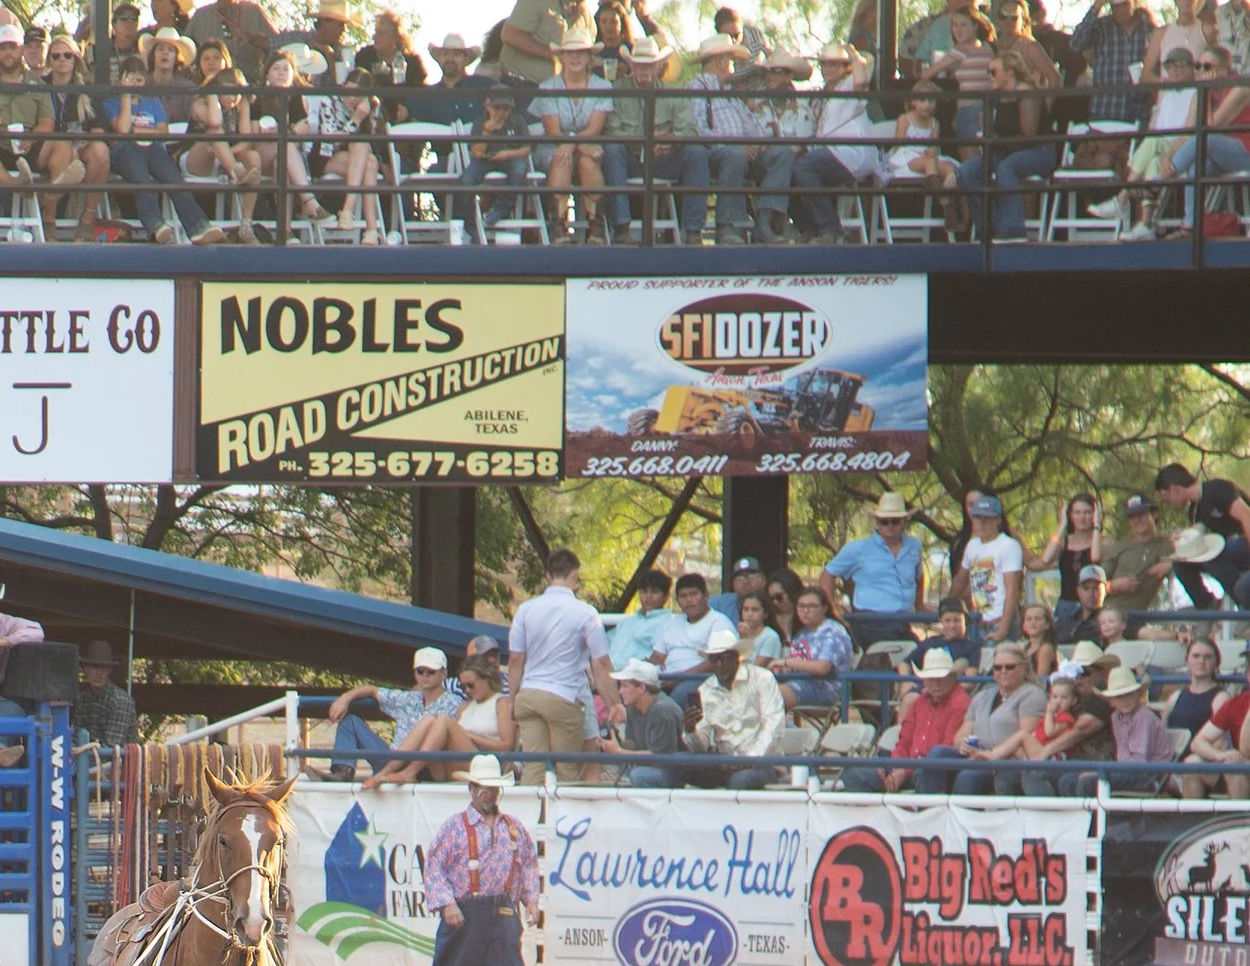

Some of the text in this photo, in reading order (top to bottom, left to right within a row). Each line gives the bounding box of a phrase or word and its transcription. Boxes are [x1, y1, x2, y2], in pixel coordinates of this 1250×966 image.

[587, 279, 639, 290] PROUD
[643, 278, 729, 290] SUPPORTER
[733, 277, 753, 288] OF
[757, 277, 784, 287] THE
[788, 276, 839, 287] ANSON
[106, 304, 161, 354] CO
[220, 295, 465, 355] NOBLES
[217, 338, 561, 474] ROAD CONSTRUCTION
[464, 409, 530, 423] ABILENE,
[475, 423, 519, 435] TEXAS
[278, 451, 560, 477] PH. 325-677-6258
[581, 454, 730, 477] 325.668.0411
[755, 450, 912, 473] 325.668.4804
[549, 815, 801, 902] Lawrence Hall
[51, 820, 66, 947] RODEO
[900, 835, 1068, 922] Big Red's
[391, 889, 442, 918] FAR
[1163, 894, 1250, 944] SILE
